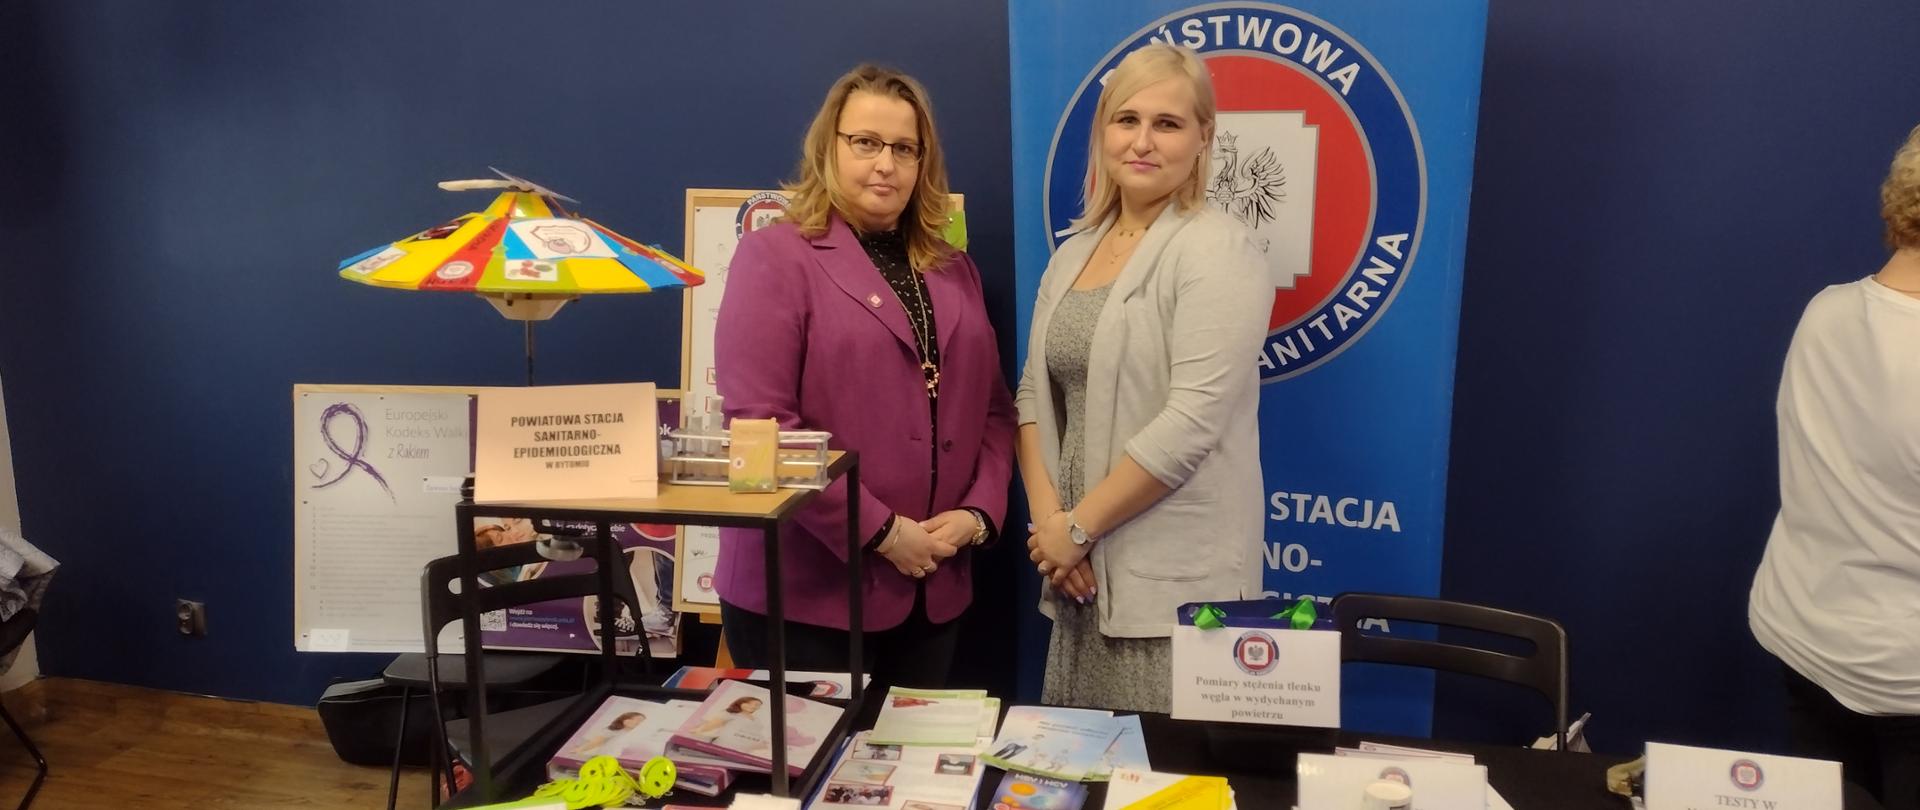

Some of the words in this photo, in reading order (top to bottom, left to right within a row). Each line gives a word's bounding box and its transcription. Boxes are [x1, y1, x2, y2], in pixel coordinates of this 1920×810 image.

[1257, 233, 1409, 370] ANITARNA
[385, 408, 448, 422] Europejski
[511, 415, 581, 427] POWIATOWA
[584, 413, 624, 424] STACJA
[385, 425, 431, 438] Kodeks
[534, 429, 601, 441] SANITARNO-
[513, 444, 621, 458] EPIDEMIOLOGICZNA
[1270, 491, 1401, 532] STACJA
[1195, 676, 1238, 689] Pomiary
[1243, 679, 1284, 690] stężenia
[1287, 682, 1321, 692] tlenku
[1201, 692, 1230, 703] węgla
[1233, 694, 1241, 702] w
[1245, 695, 1316, 708] wydychanym
[1231, 709, 1284, 720] powietrzu
[1715, 794, 1760, 809] TESTY
